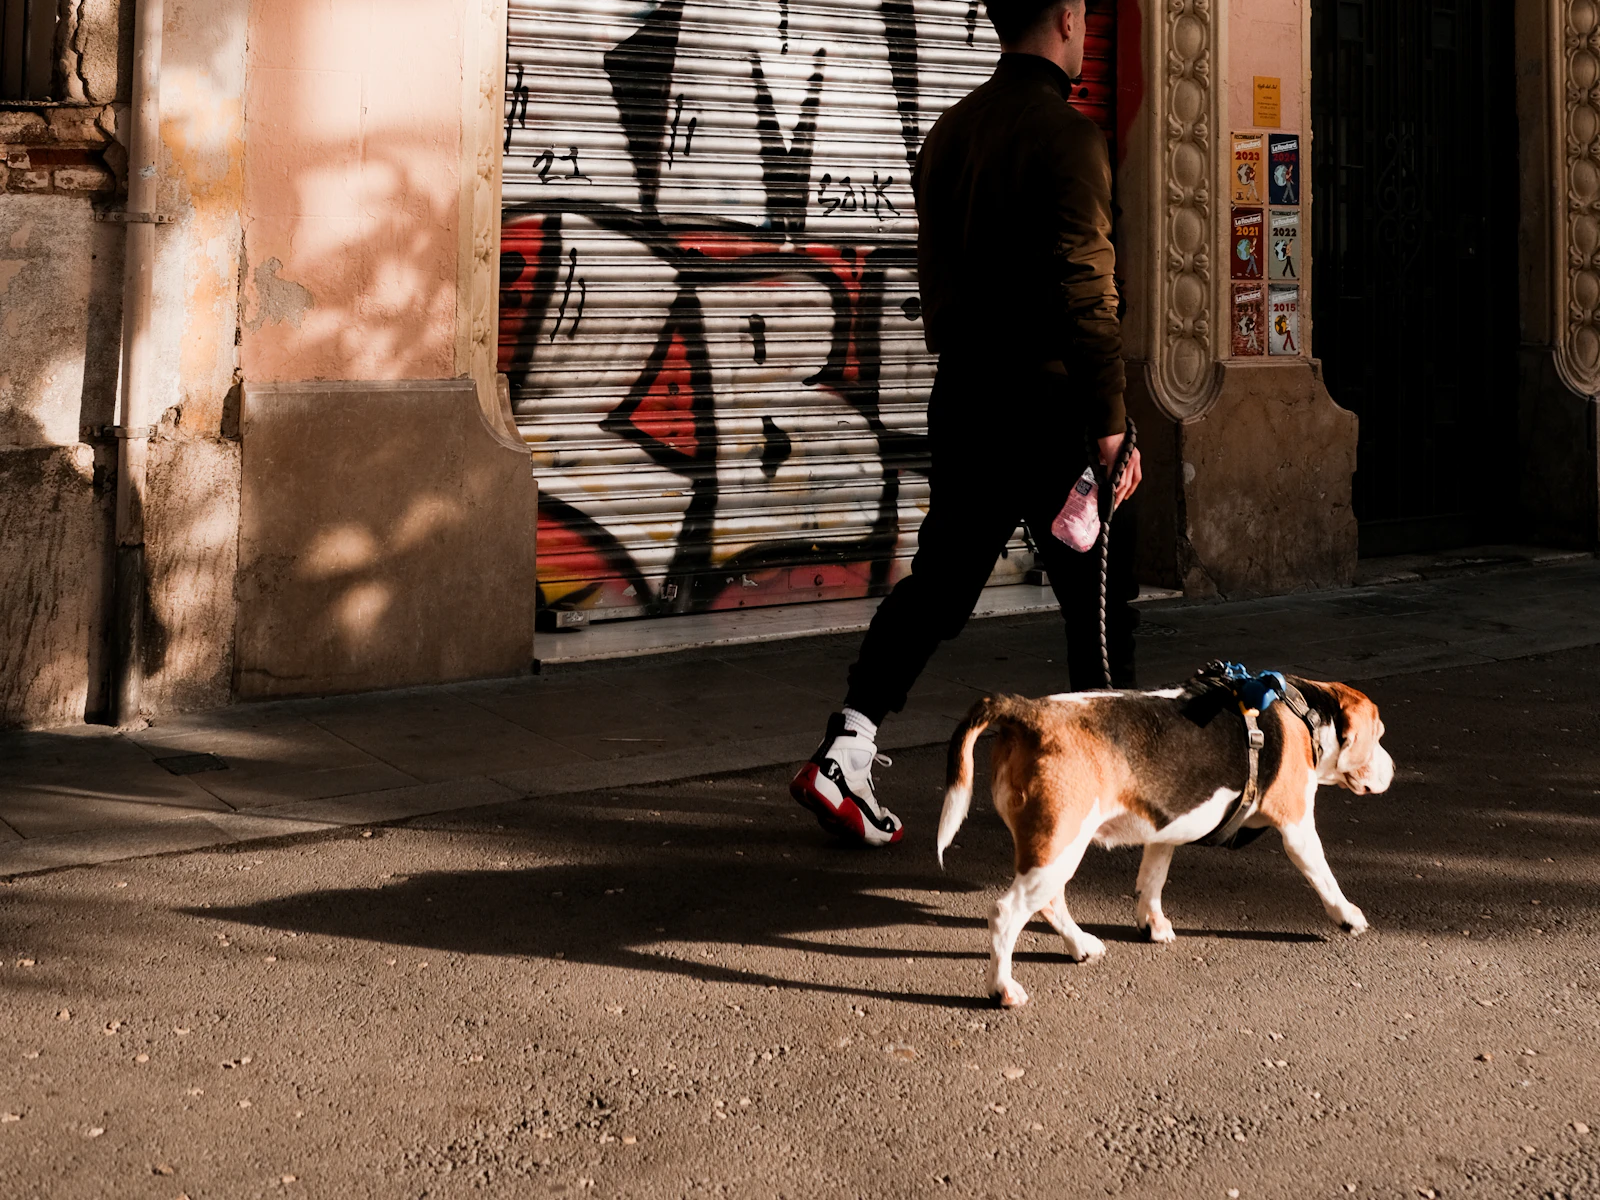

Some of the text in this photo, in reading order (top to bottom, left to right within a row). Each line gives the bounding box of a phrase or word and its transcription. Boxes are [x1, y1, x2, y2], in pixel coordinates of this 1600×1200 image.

[1241, 140, 1261, 149] Routard
[1277, 141, 1297, 151] Routard
[1235, 151, 1260, 161] 2023
[1273, 152, 1297, 162] 2024
[1241, 215, 1261, 224] Routard
[1278, 216, 1297, 225] Routard
[1235, 226, 1259, 236] 2021
[1273, 227, 1297, 237] 2022
[1273, 303, 1296, 312] 2015
